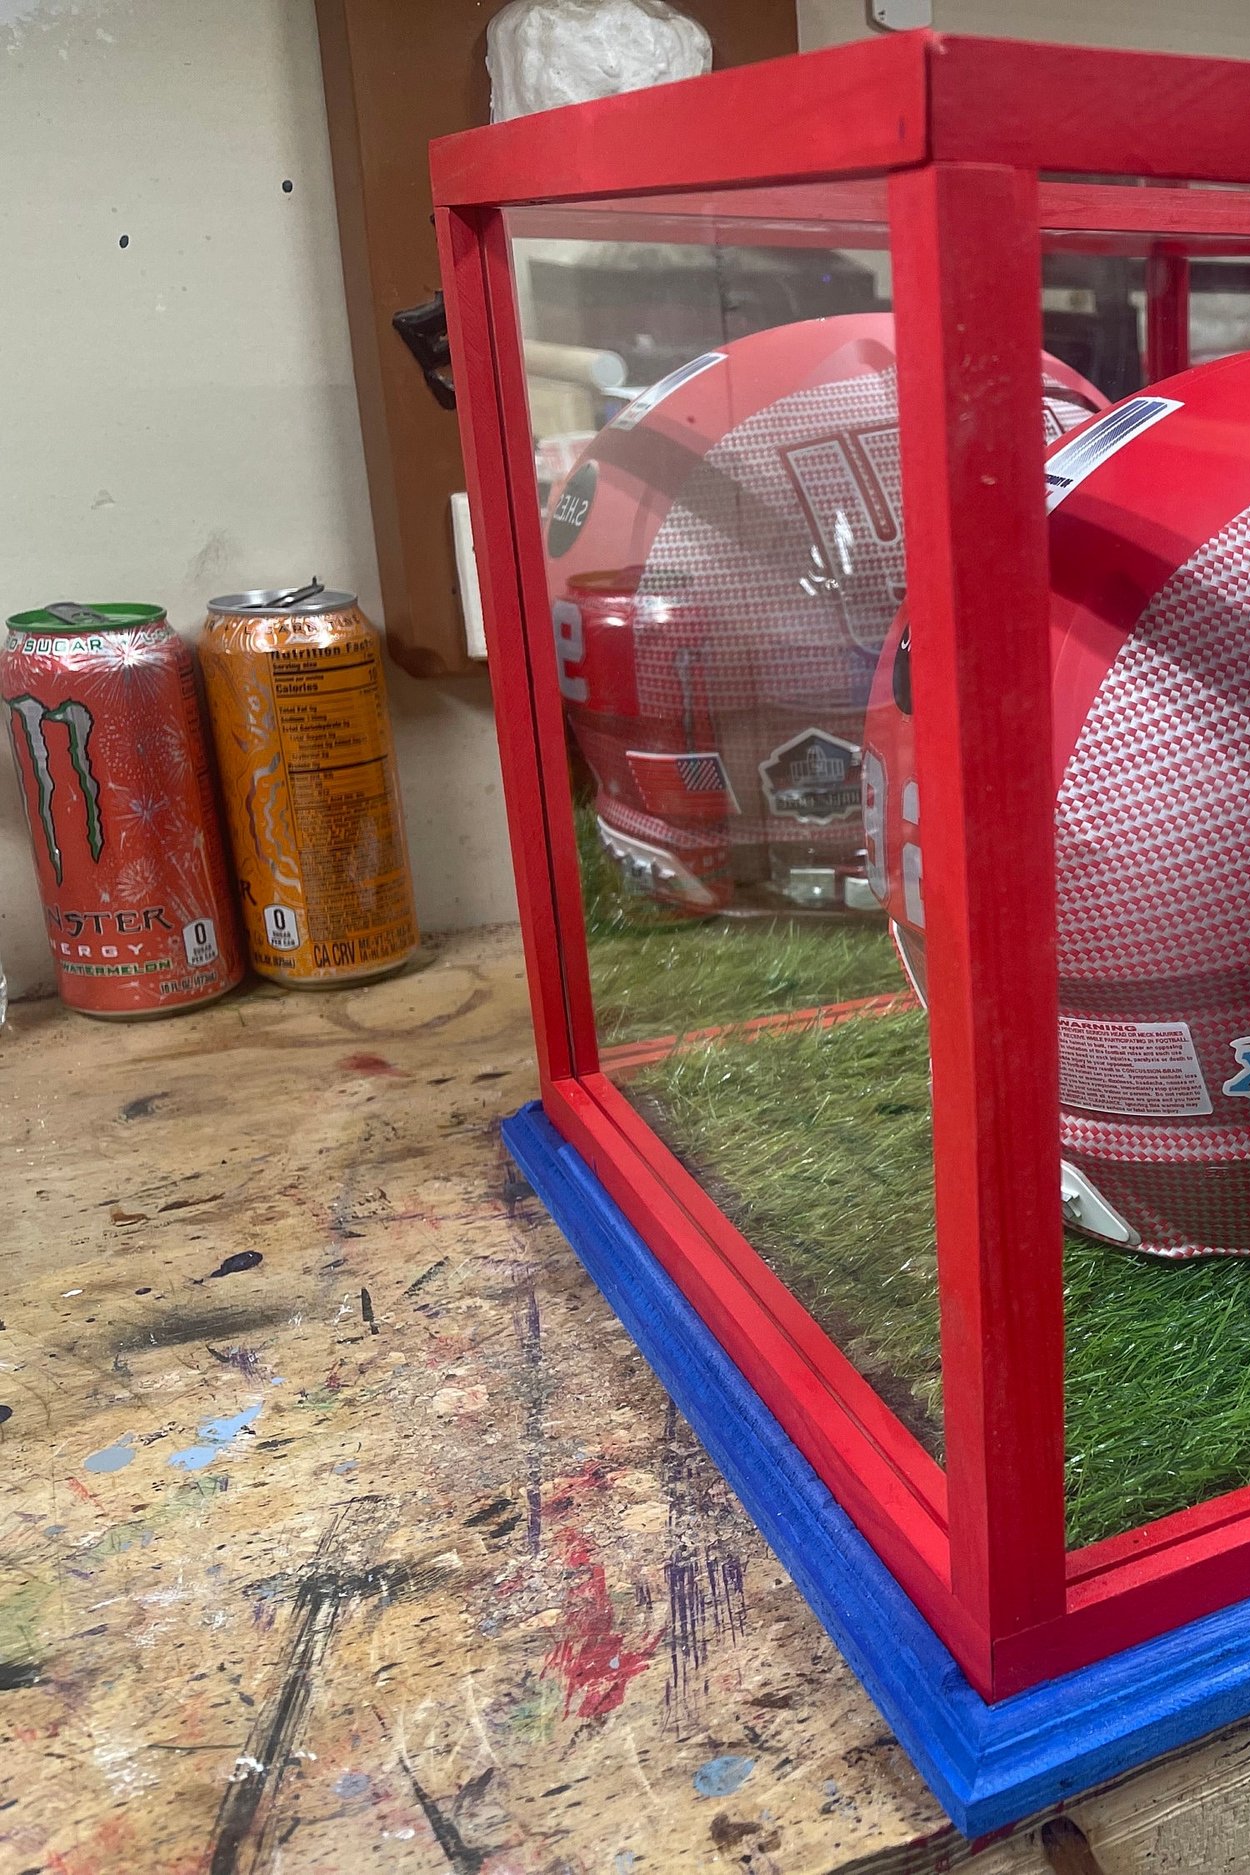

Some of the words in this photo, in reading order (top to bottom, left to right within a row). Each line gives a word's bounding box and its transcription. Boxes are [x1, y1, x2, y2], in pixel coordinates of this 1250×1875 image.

[22, 635, 106, 655] SUGAR
[271, 645, 341, 660] Nutrition
[47, 903, 175, 939] NSTER
[273, 909, 286, 930] 0
[195, 922, 207, 945] 0
[313, 943, 331, 968] CA
[331, 940, 355, 966] CRV
[61, 958, 173, 977] WATERMELON
[1058, 1020, 1137, 1031] WARNING
